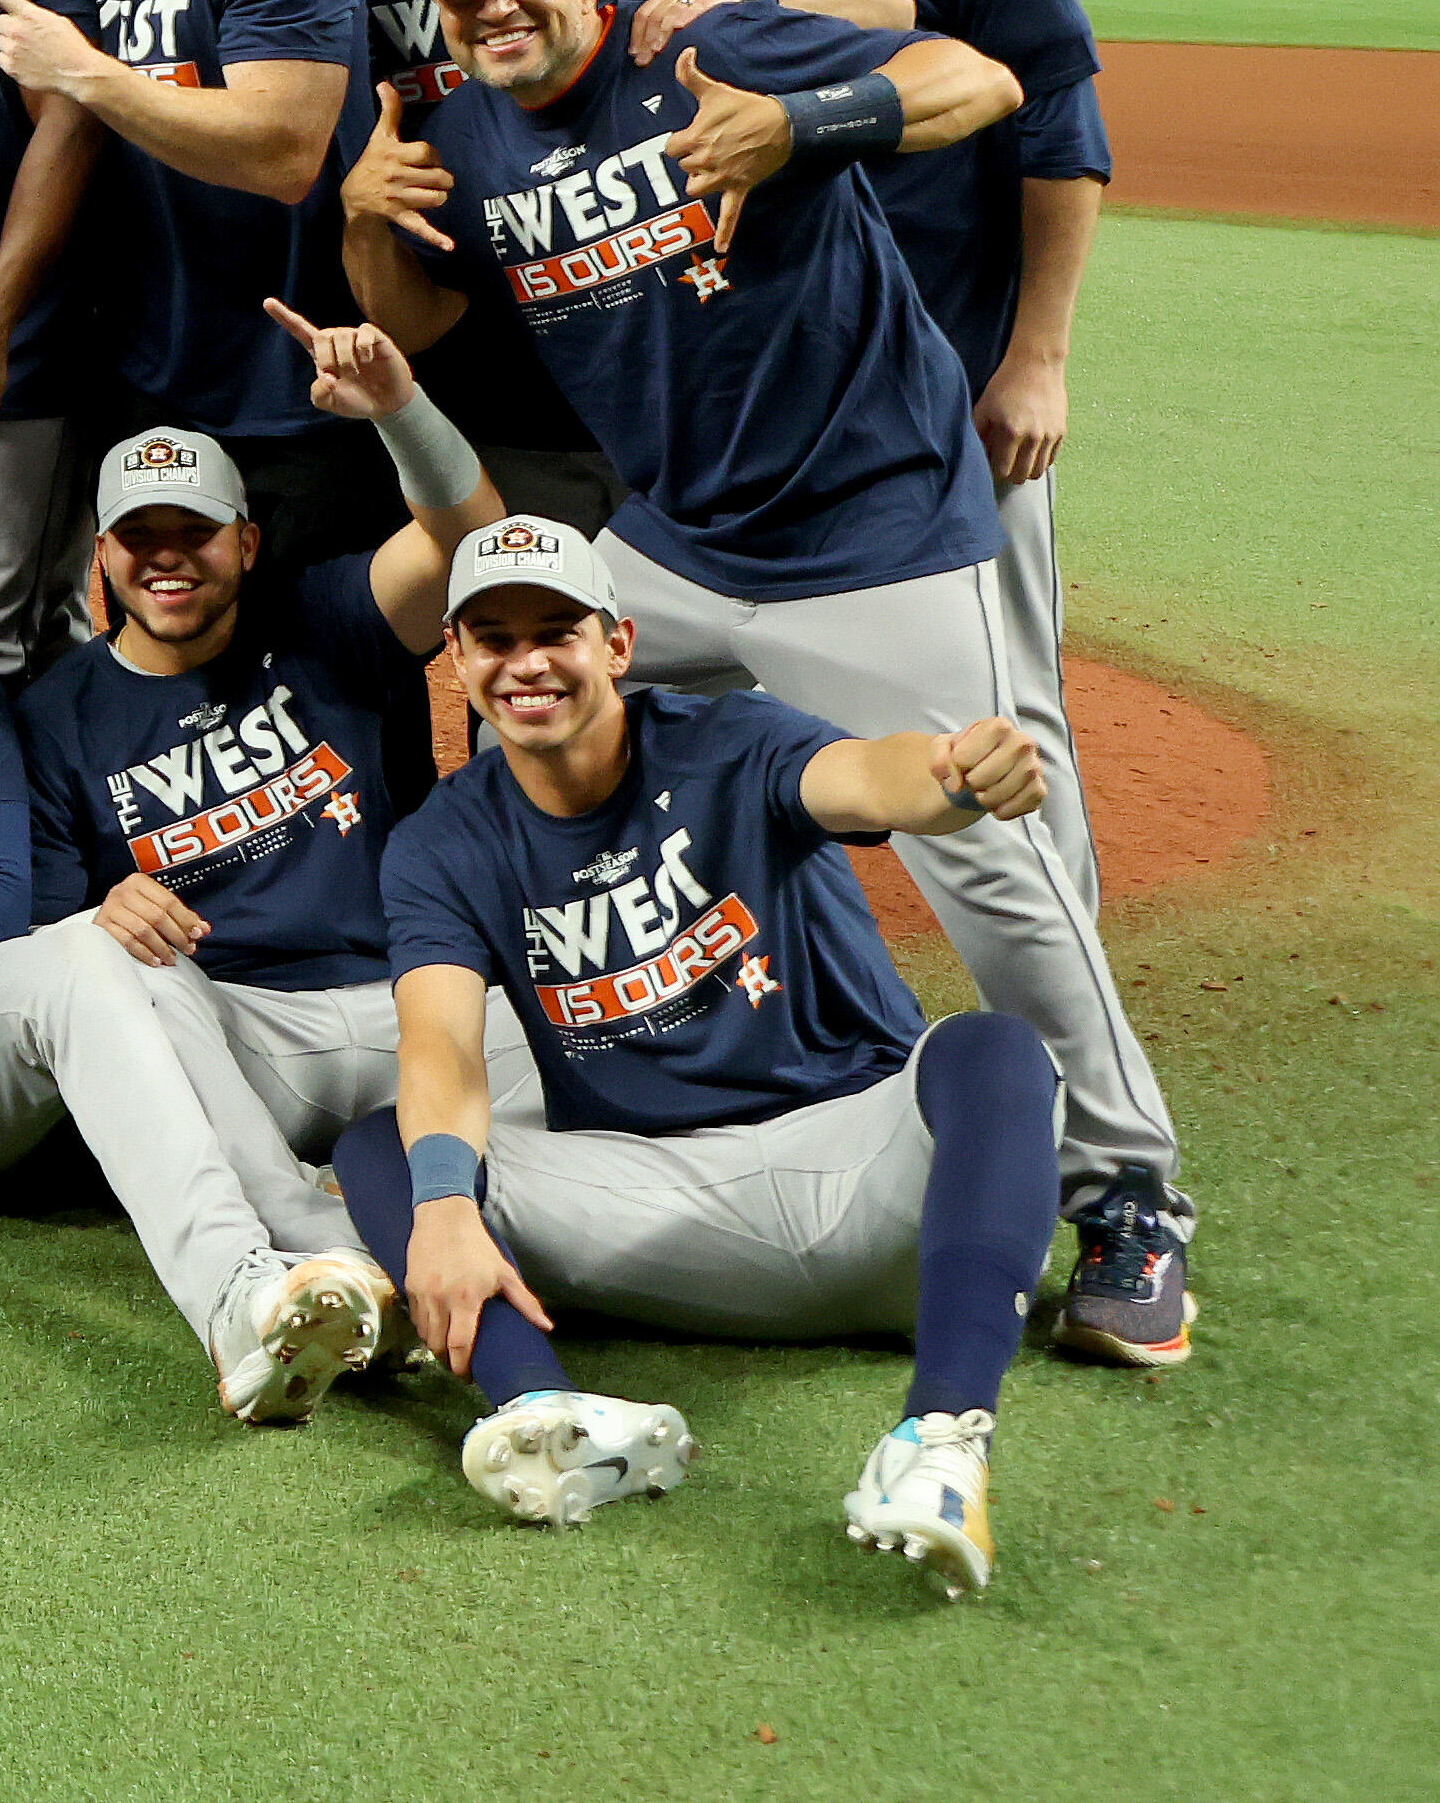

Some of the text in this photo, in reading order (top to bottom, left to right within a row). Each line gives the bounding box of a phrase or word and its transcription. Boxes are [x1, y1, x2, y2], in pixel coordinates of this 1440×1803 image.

[483, 132, 680, 260] THE WEST
[517, 213, 692, 298] IS OURS
[476, 551, 558, 568] DIVISION CHAMPS
[523, 827, 712, 979] THE WEST
[573, 847, 639, 883] POSTSEASON
[558, 910, 743, 1023] IS OURS
